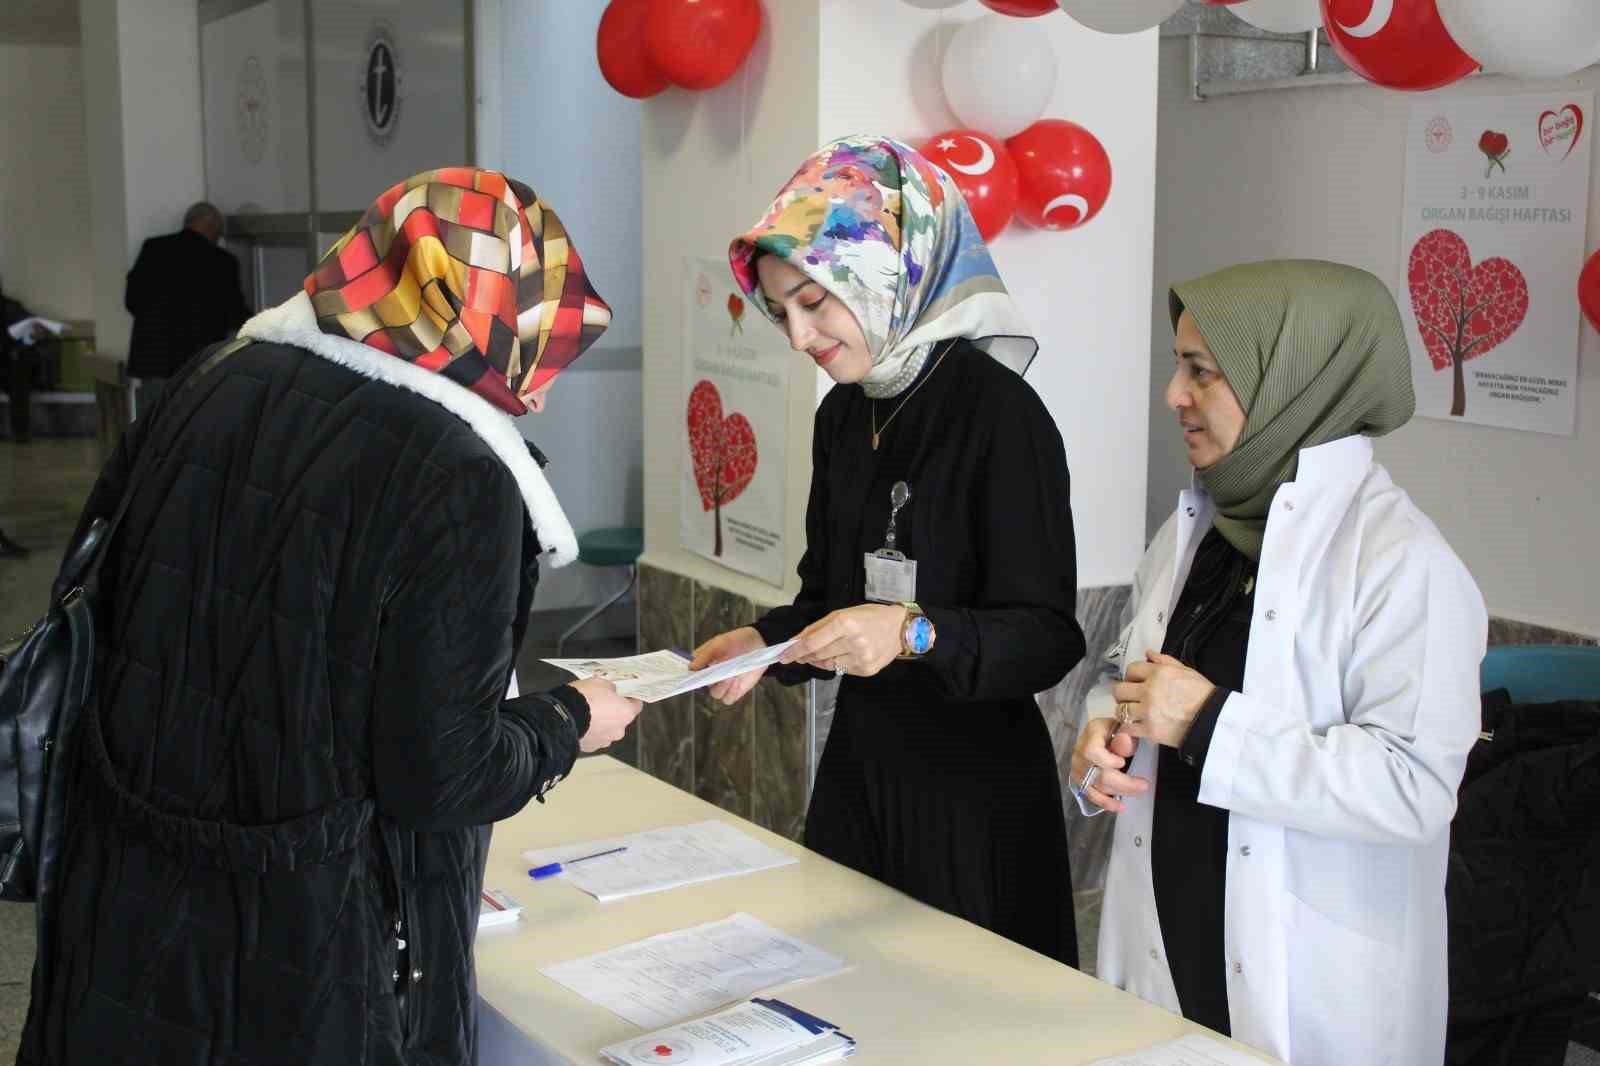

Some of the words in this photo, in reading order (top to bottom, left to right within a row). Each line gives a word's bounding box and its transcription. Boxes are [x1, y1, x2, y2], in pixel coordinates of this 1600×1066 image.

[1488, 185, 1530, 201] KASIM
[1421, 207, 1466, 223] ORGAN
[1468, 204, 1510, 225] BAĞIŞI
[1513, 208, 1572, 225] HAFTASI
